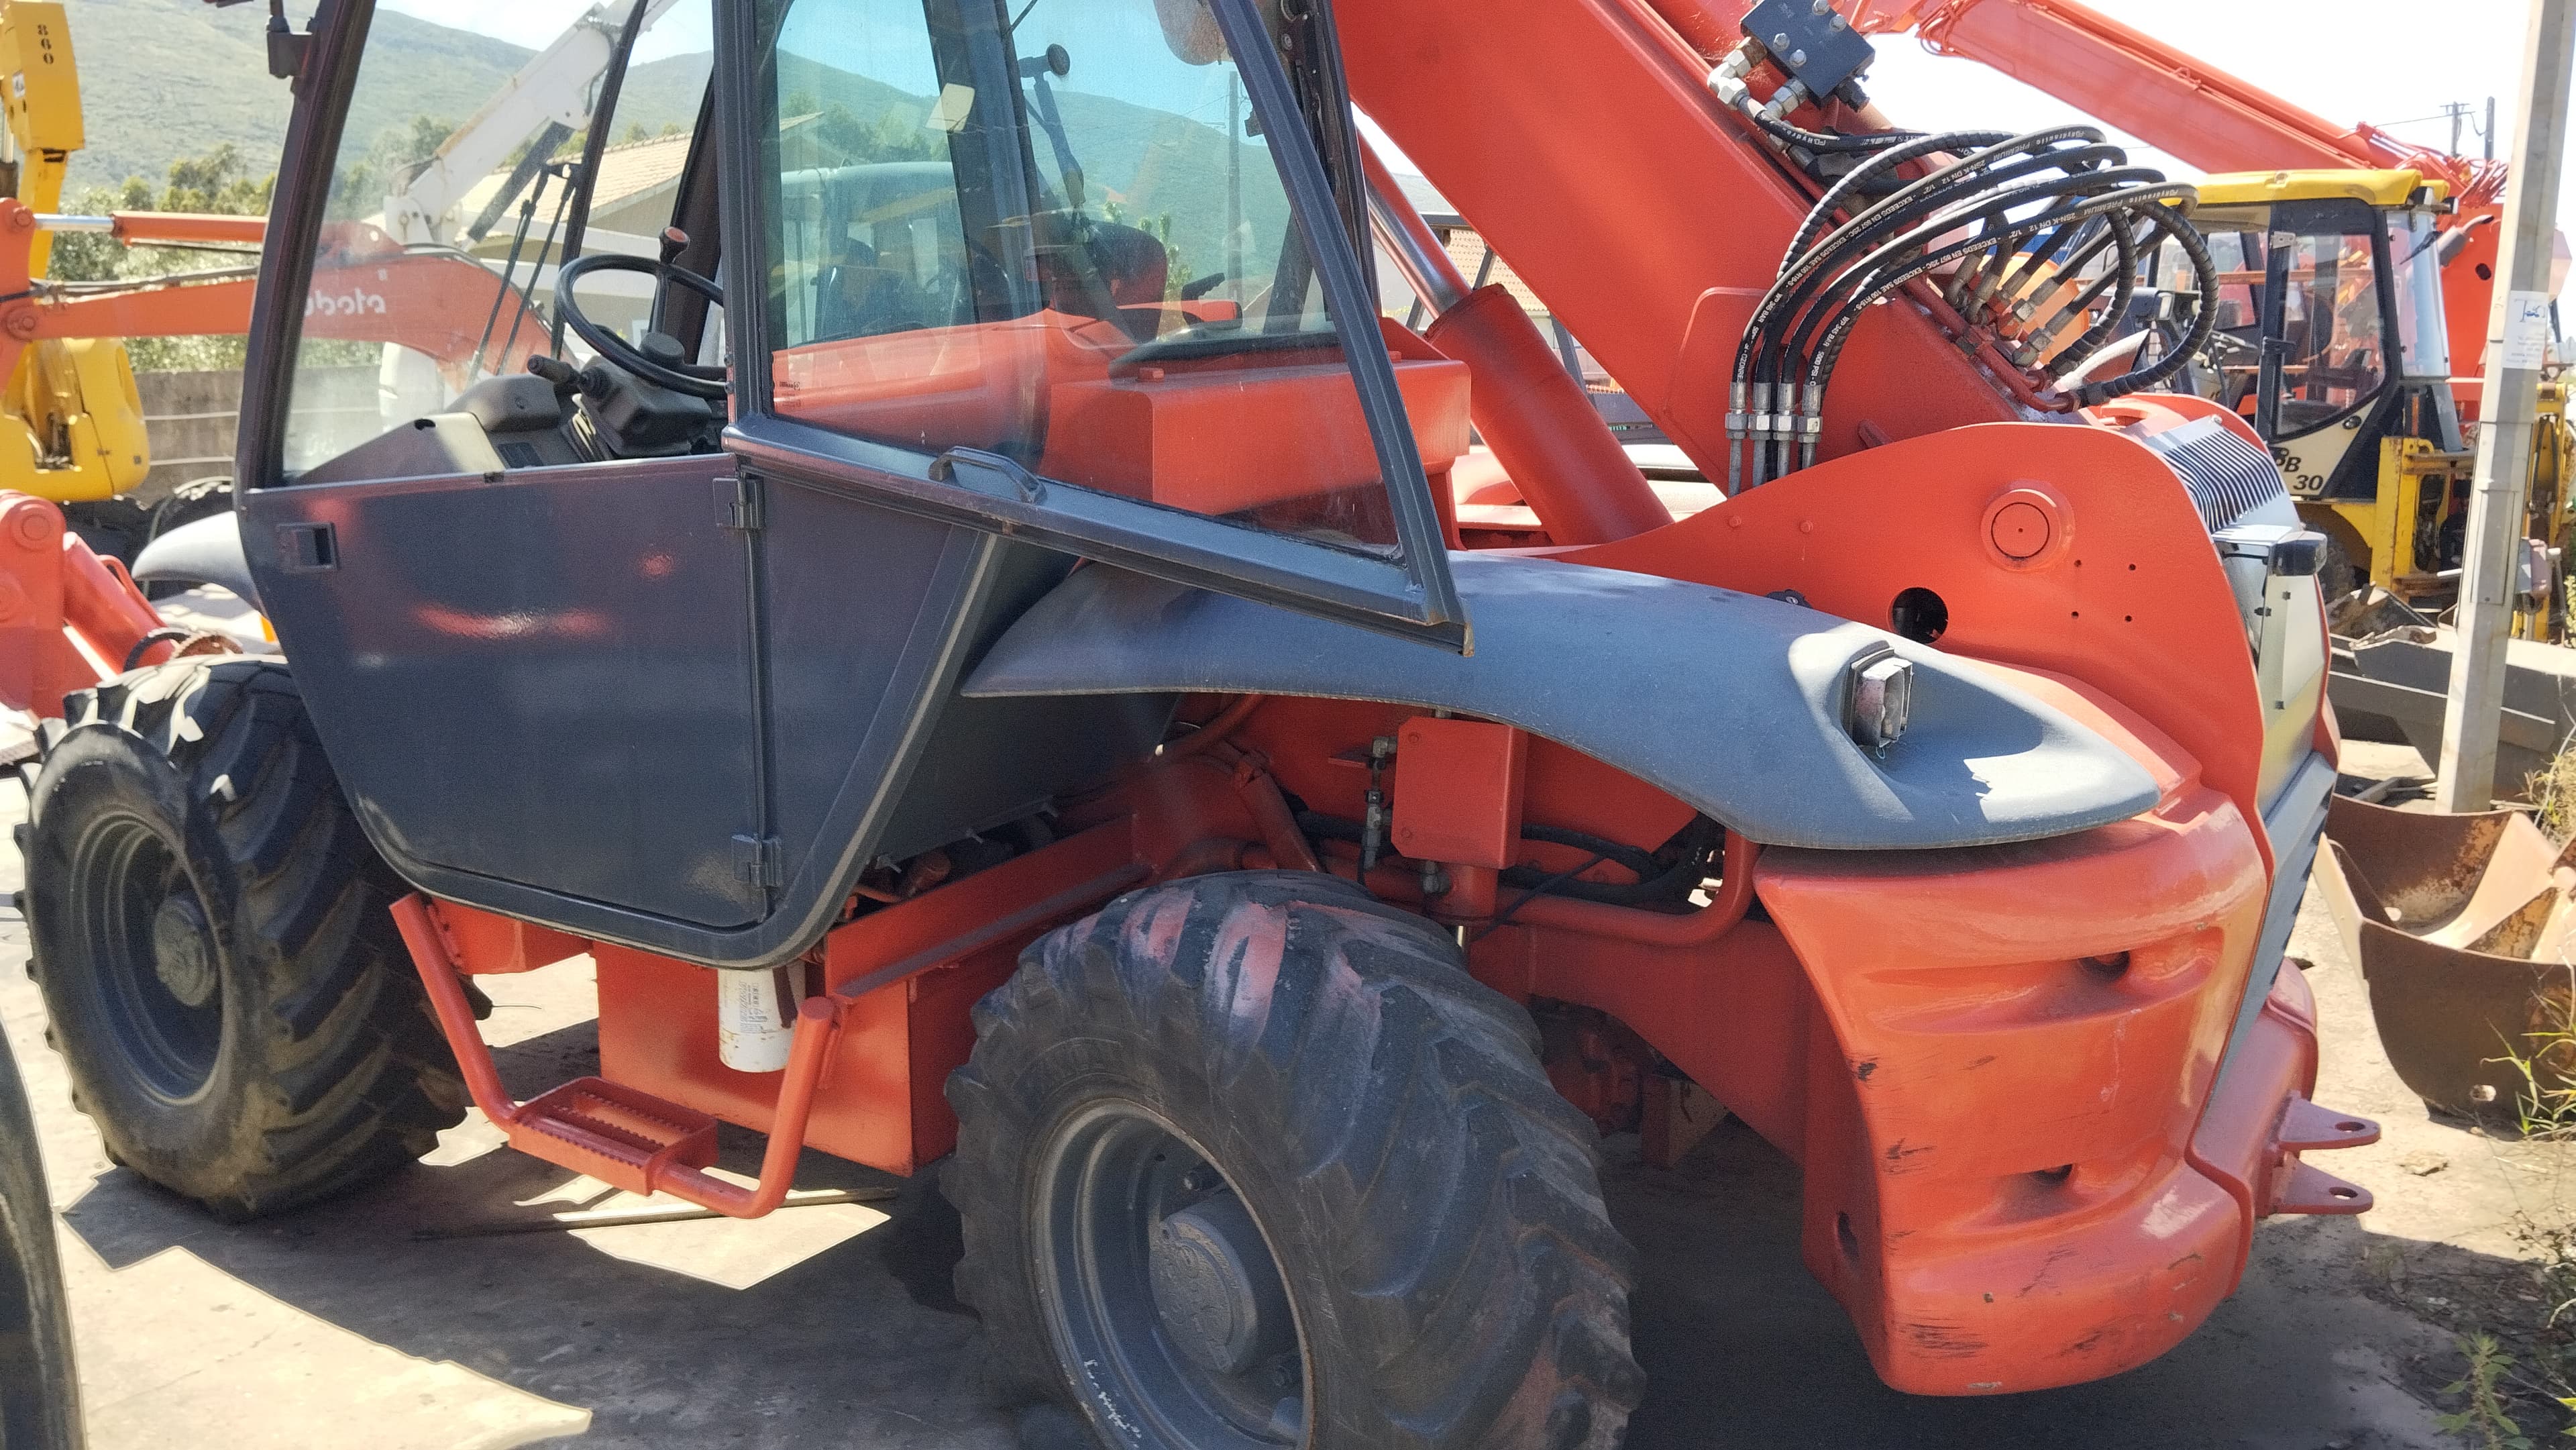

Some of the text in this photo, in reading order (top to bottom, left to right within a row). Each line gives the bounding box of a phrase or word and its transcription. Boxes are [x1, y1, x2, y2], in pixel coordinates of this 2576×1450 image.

[1994, 142, 2031, 160] PREMIUM
[1882, 197, 1913, 217] EXCEEDS
[2084, 200, 2123, 216] PREMIUM
[1822, 237, 1847, 258] EXCEEDS
[1964, 237, 1998, 255] EXCEEDS
[1894, 266, 1923, 285] EXCEEDS
[1758, 311, 1769, 323] BAR
[1823, 334, 1835, 347] BAR
[2293, 474, 2324, 490] 30
